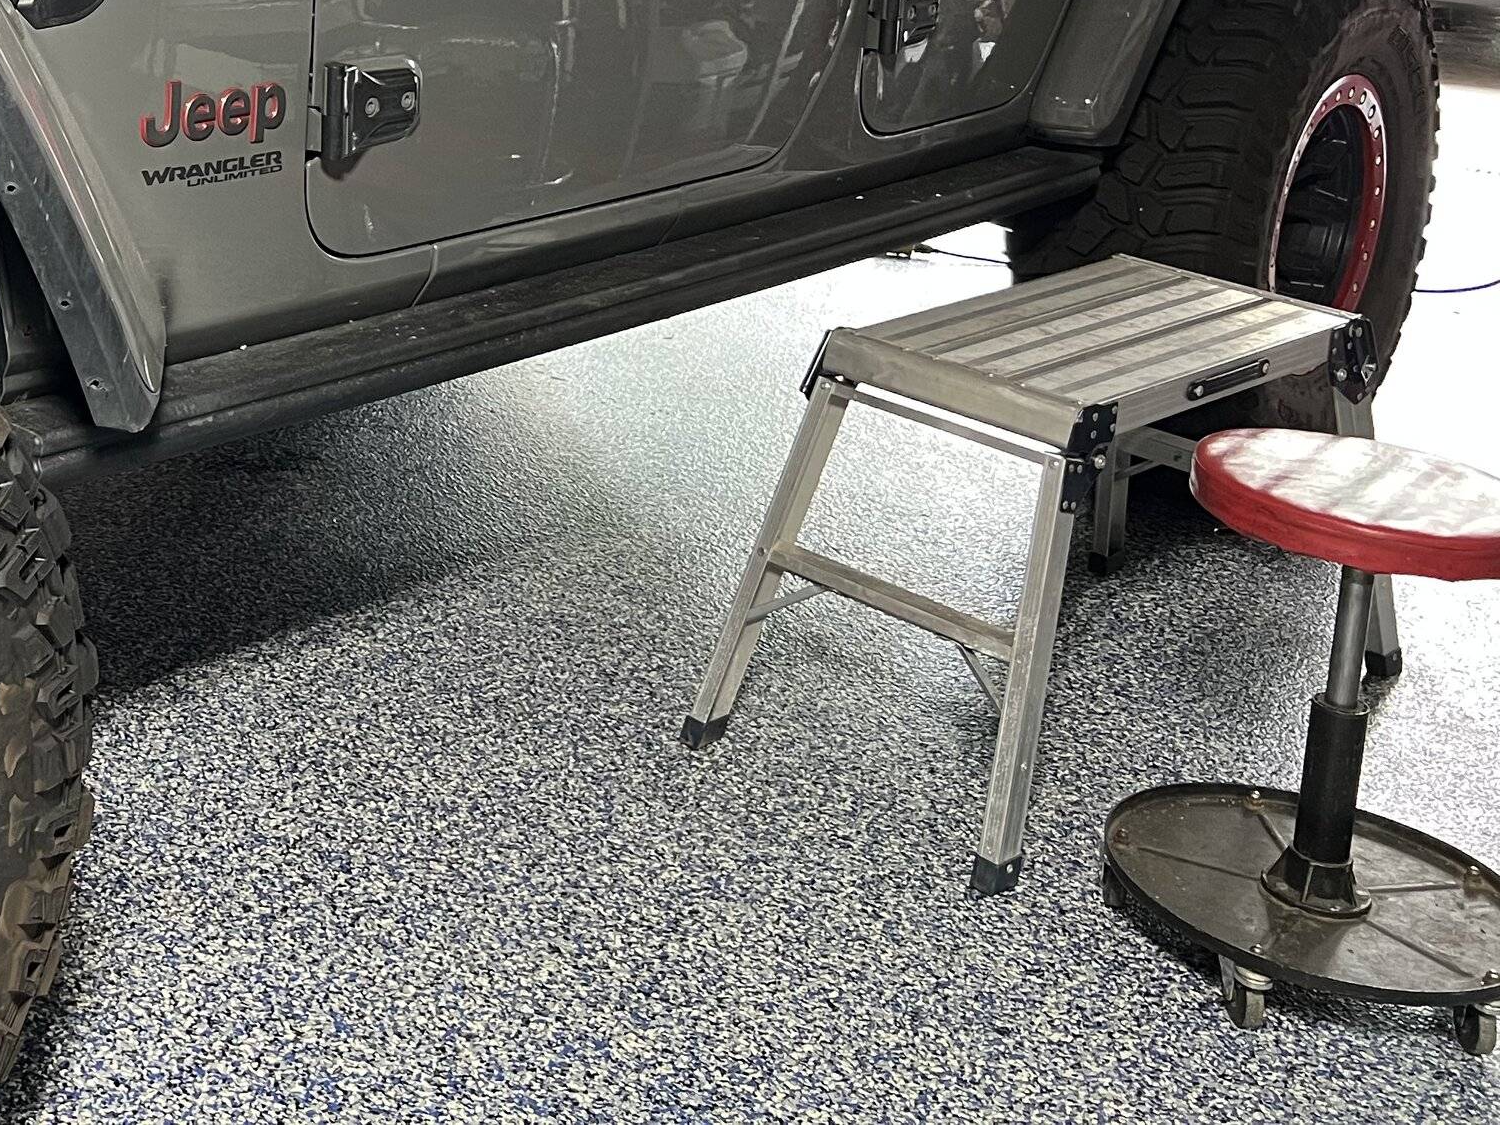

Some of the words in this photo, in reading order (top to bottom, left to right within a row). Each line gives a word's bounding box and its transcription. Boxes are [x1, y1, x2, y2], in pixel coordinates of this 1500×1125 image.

[140, 80, 286, 148] Jeep
[141, 151, 282, 186] WRANGLER
[187, 165, 282, 187] UNLIMITED
